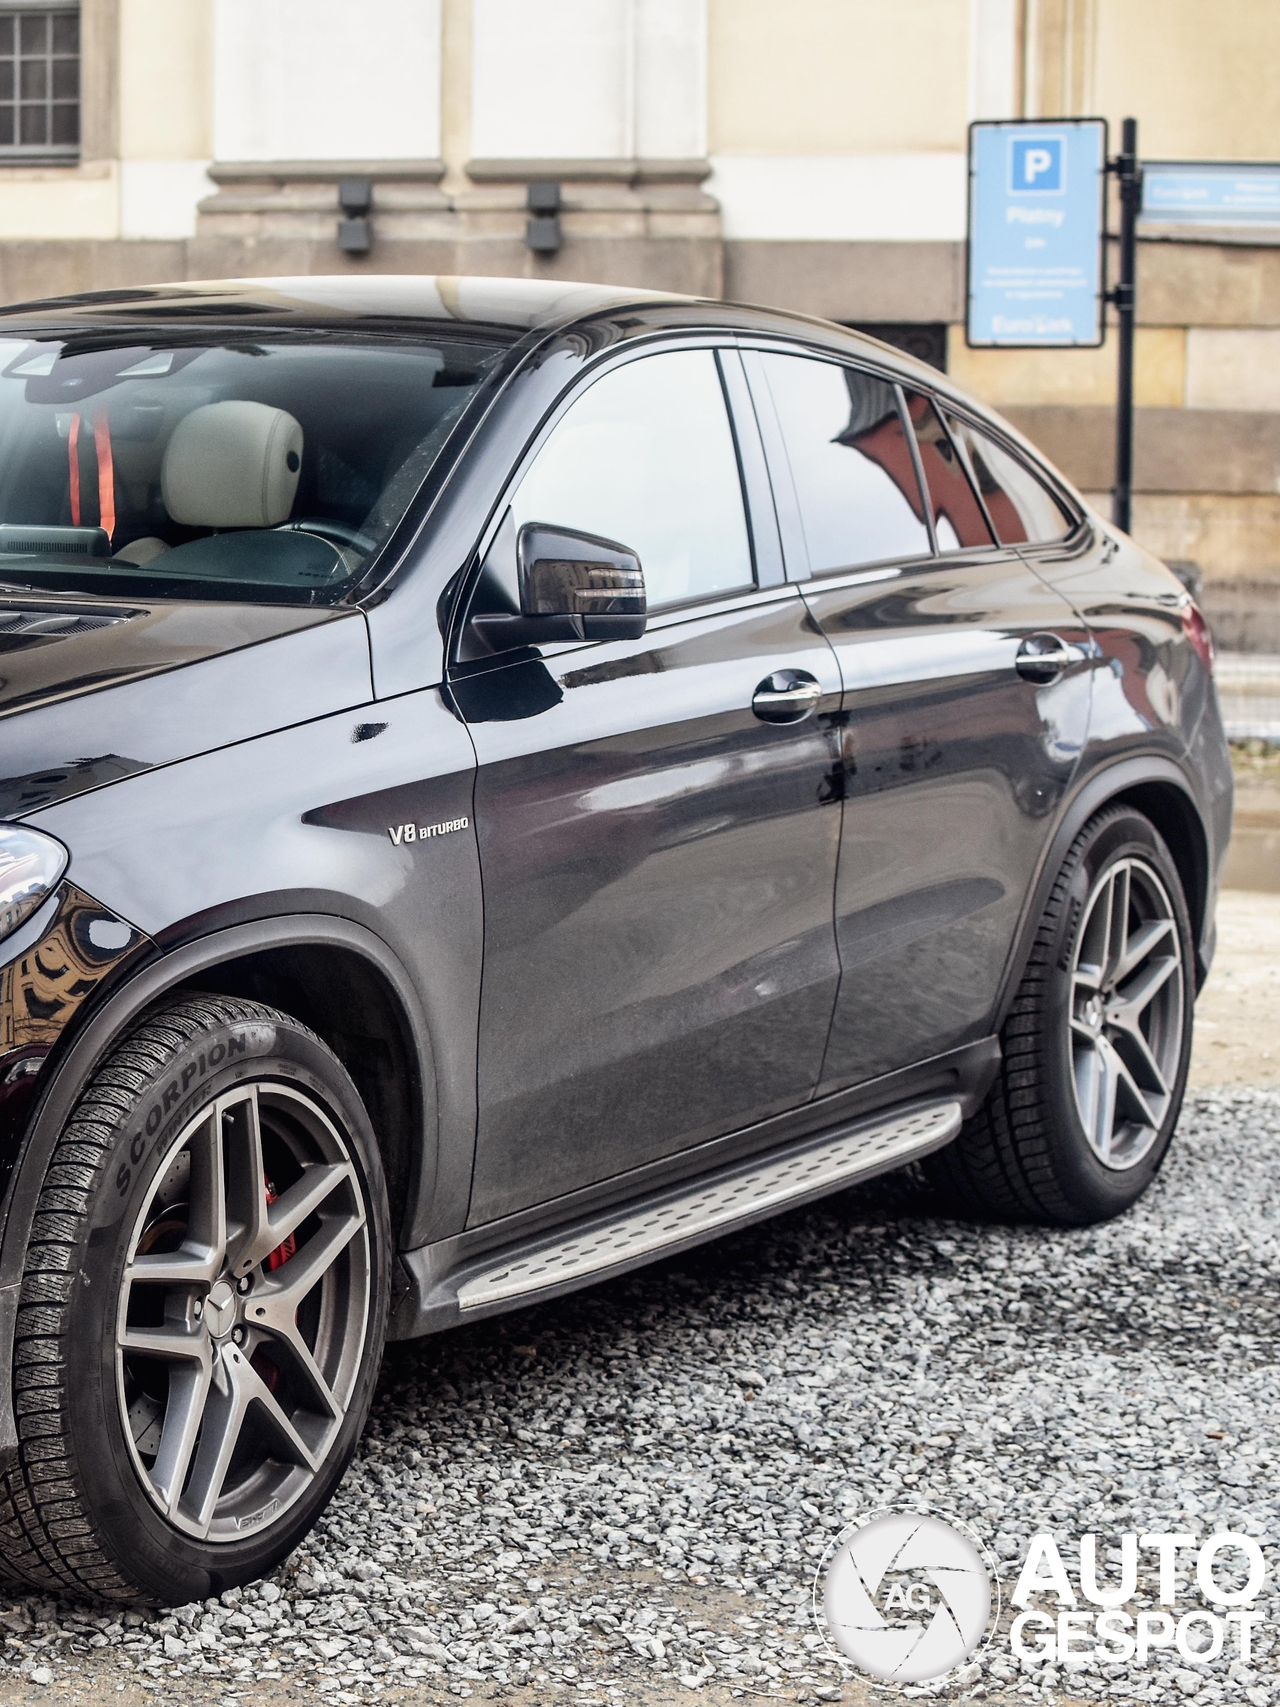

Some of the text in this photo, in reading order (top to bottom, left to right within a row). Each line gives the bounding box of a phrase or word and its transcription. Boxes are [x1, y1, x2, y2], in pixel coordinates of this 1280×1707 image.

[1025, 149, 1052, 183] P
[388, 817, 469, 846] V8 BITURBO
[116, 1033, 247, 1197] SCORPION
[157, 1081, 213, 1157] WINTER
